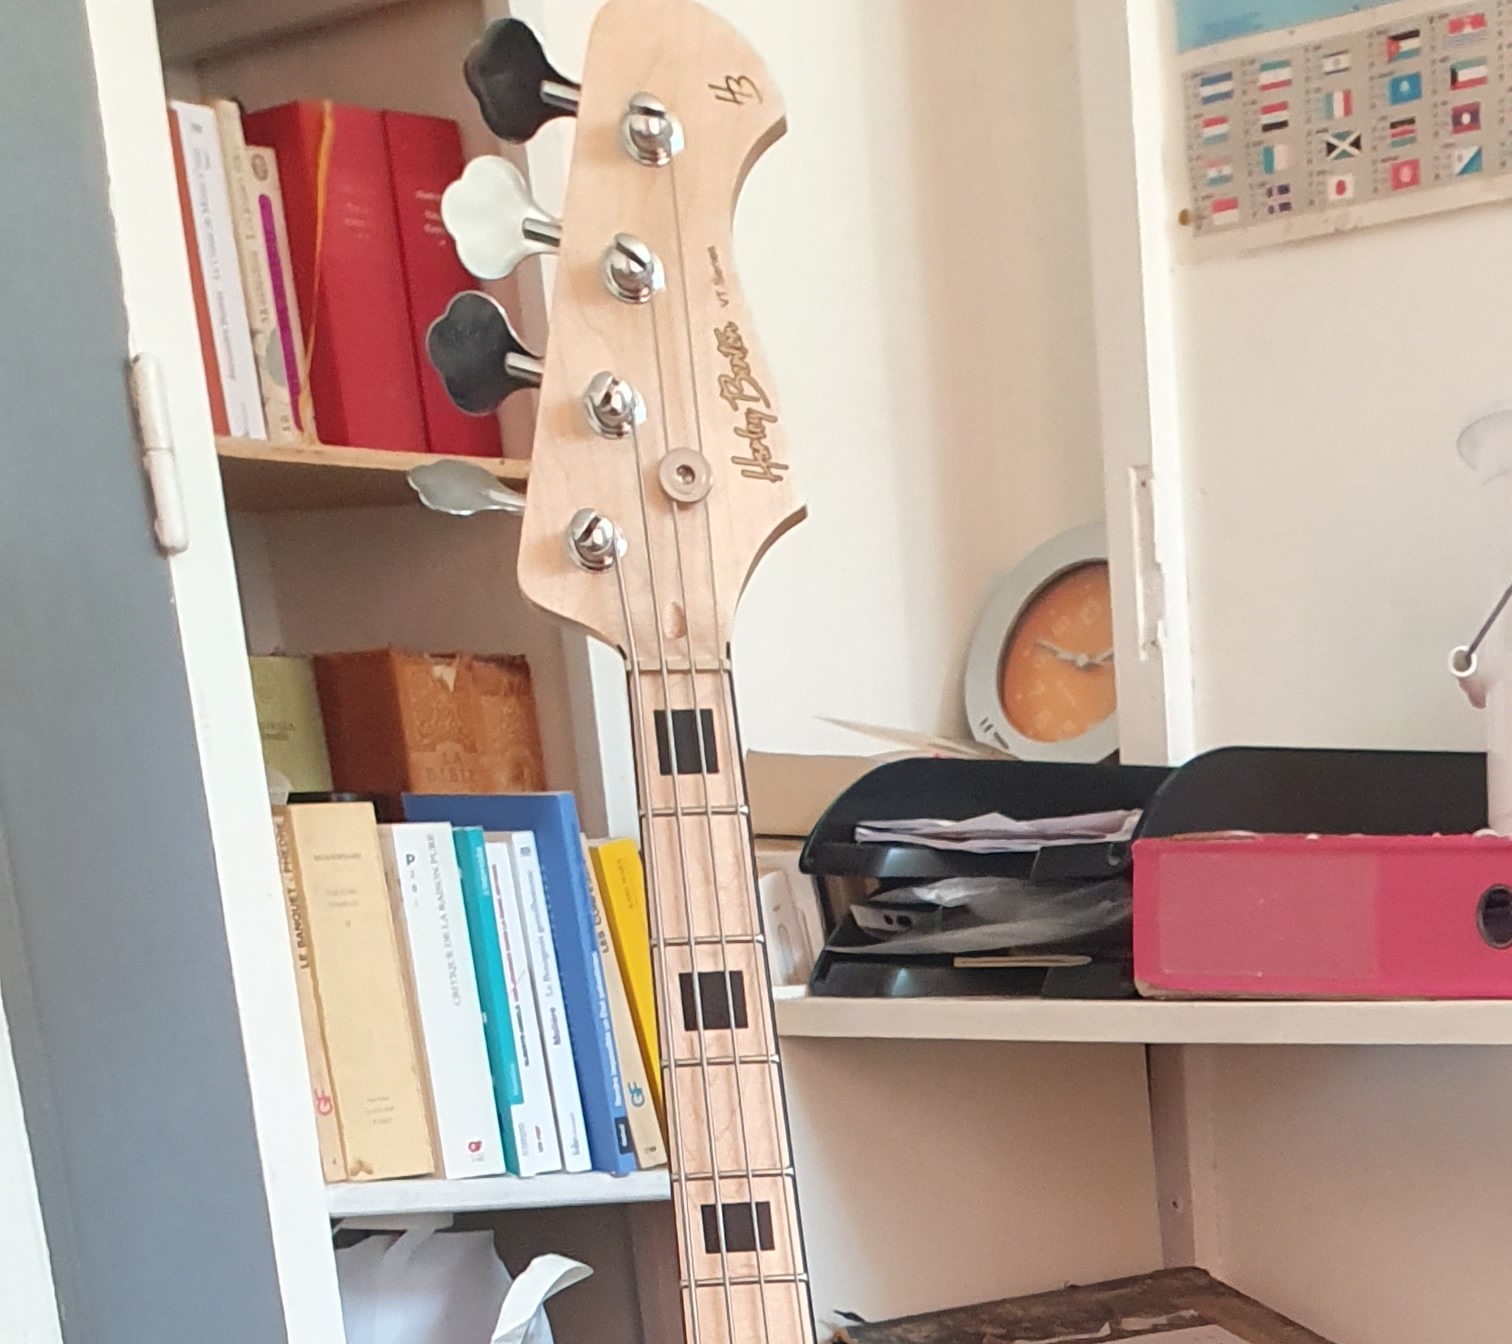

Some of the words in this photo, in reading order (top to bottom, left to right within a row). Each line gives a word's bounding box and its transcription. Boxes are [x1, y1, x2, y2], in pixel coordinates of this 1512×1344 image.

[714, 320, 772, 413] Benton
[731, 407, 790, 483] Harley
[426, 833, 439, 865] PURE
[432, 867, 446, 912] RAISON
[288, 888, 307, 948] BANQUET
[440, 912, 449, 929] LA
[442, 932, 452, 948] DE
[444, 950, 462, 1007] CRITIQUE
[314, 1088, 333, 1116] GF
[628, 1081, 646, 1109] GF
